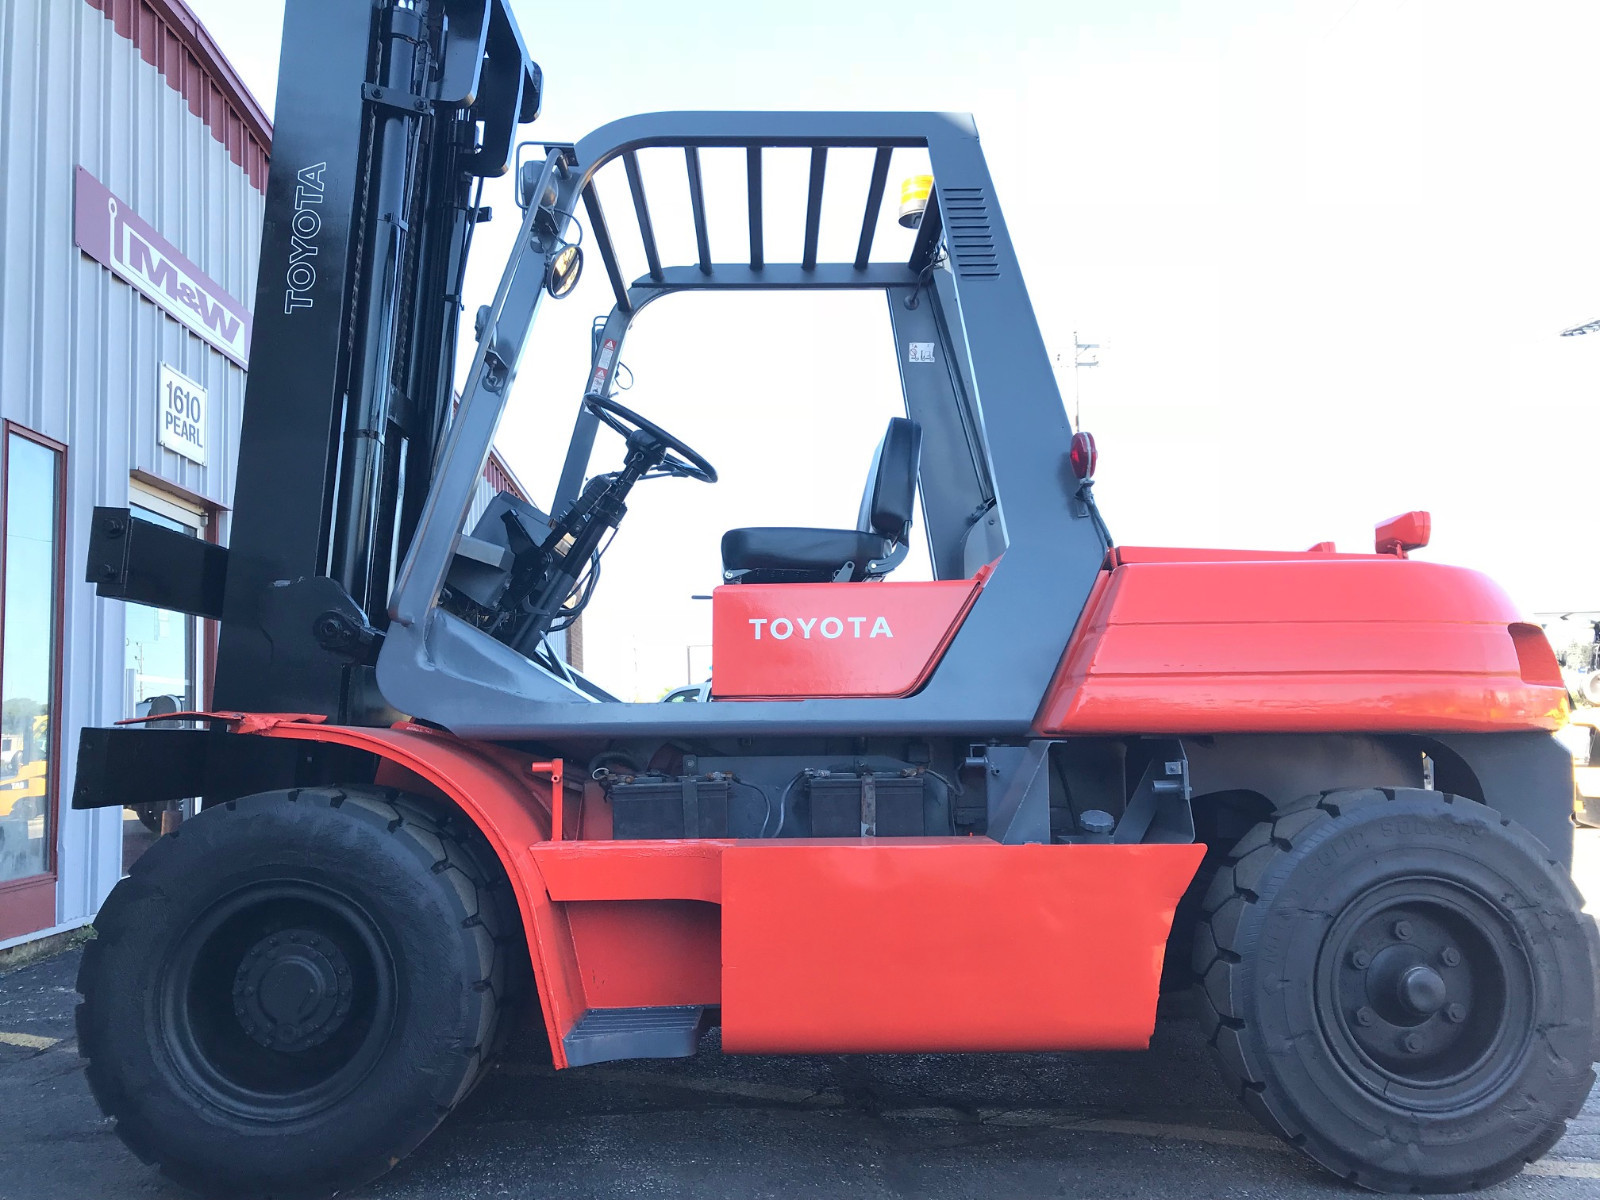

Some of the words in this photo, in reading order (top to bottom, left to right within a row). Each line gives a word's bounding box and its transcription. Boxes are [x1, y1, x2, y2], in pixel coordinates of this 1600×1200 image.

[284, 161, 327, 314] TOYOTA
[129, 231, 241, 344] M&W
[166, 380, 201, 424] 1610
[165, 410, 203, 448] PEARL
[748, 616, 894, 640] TOYOTA
